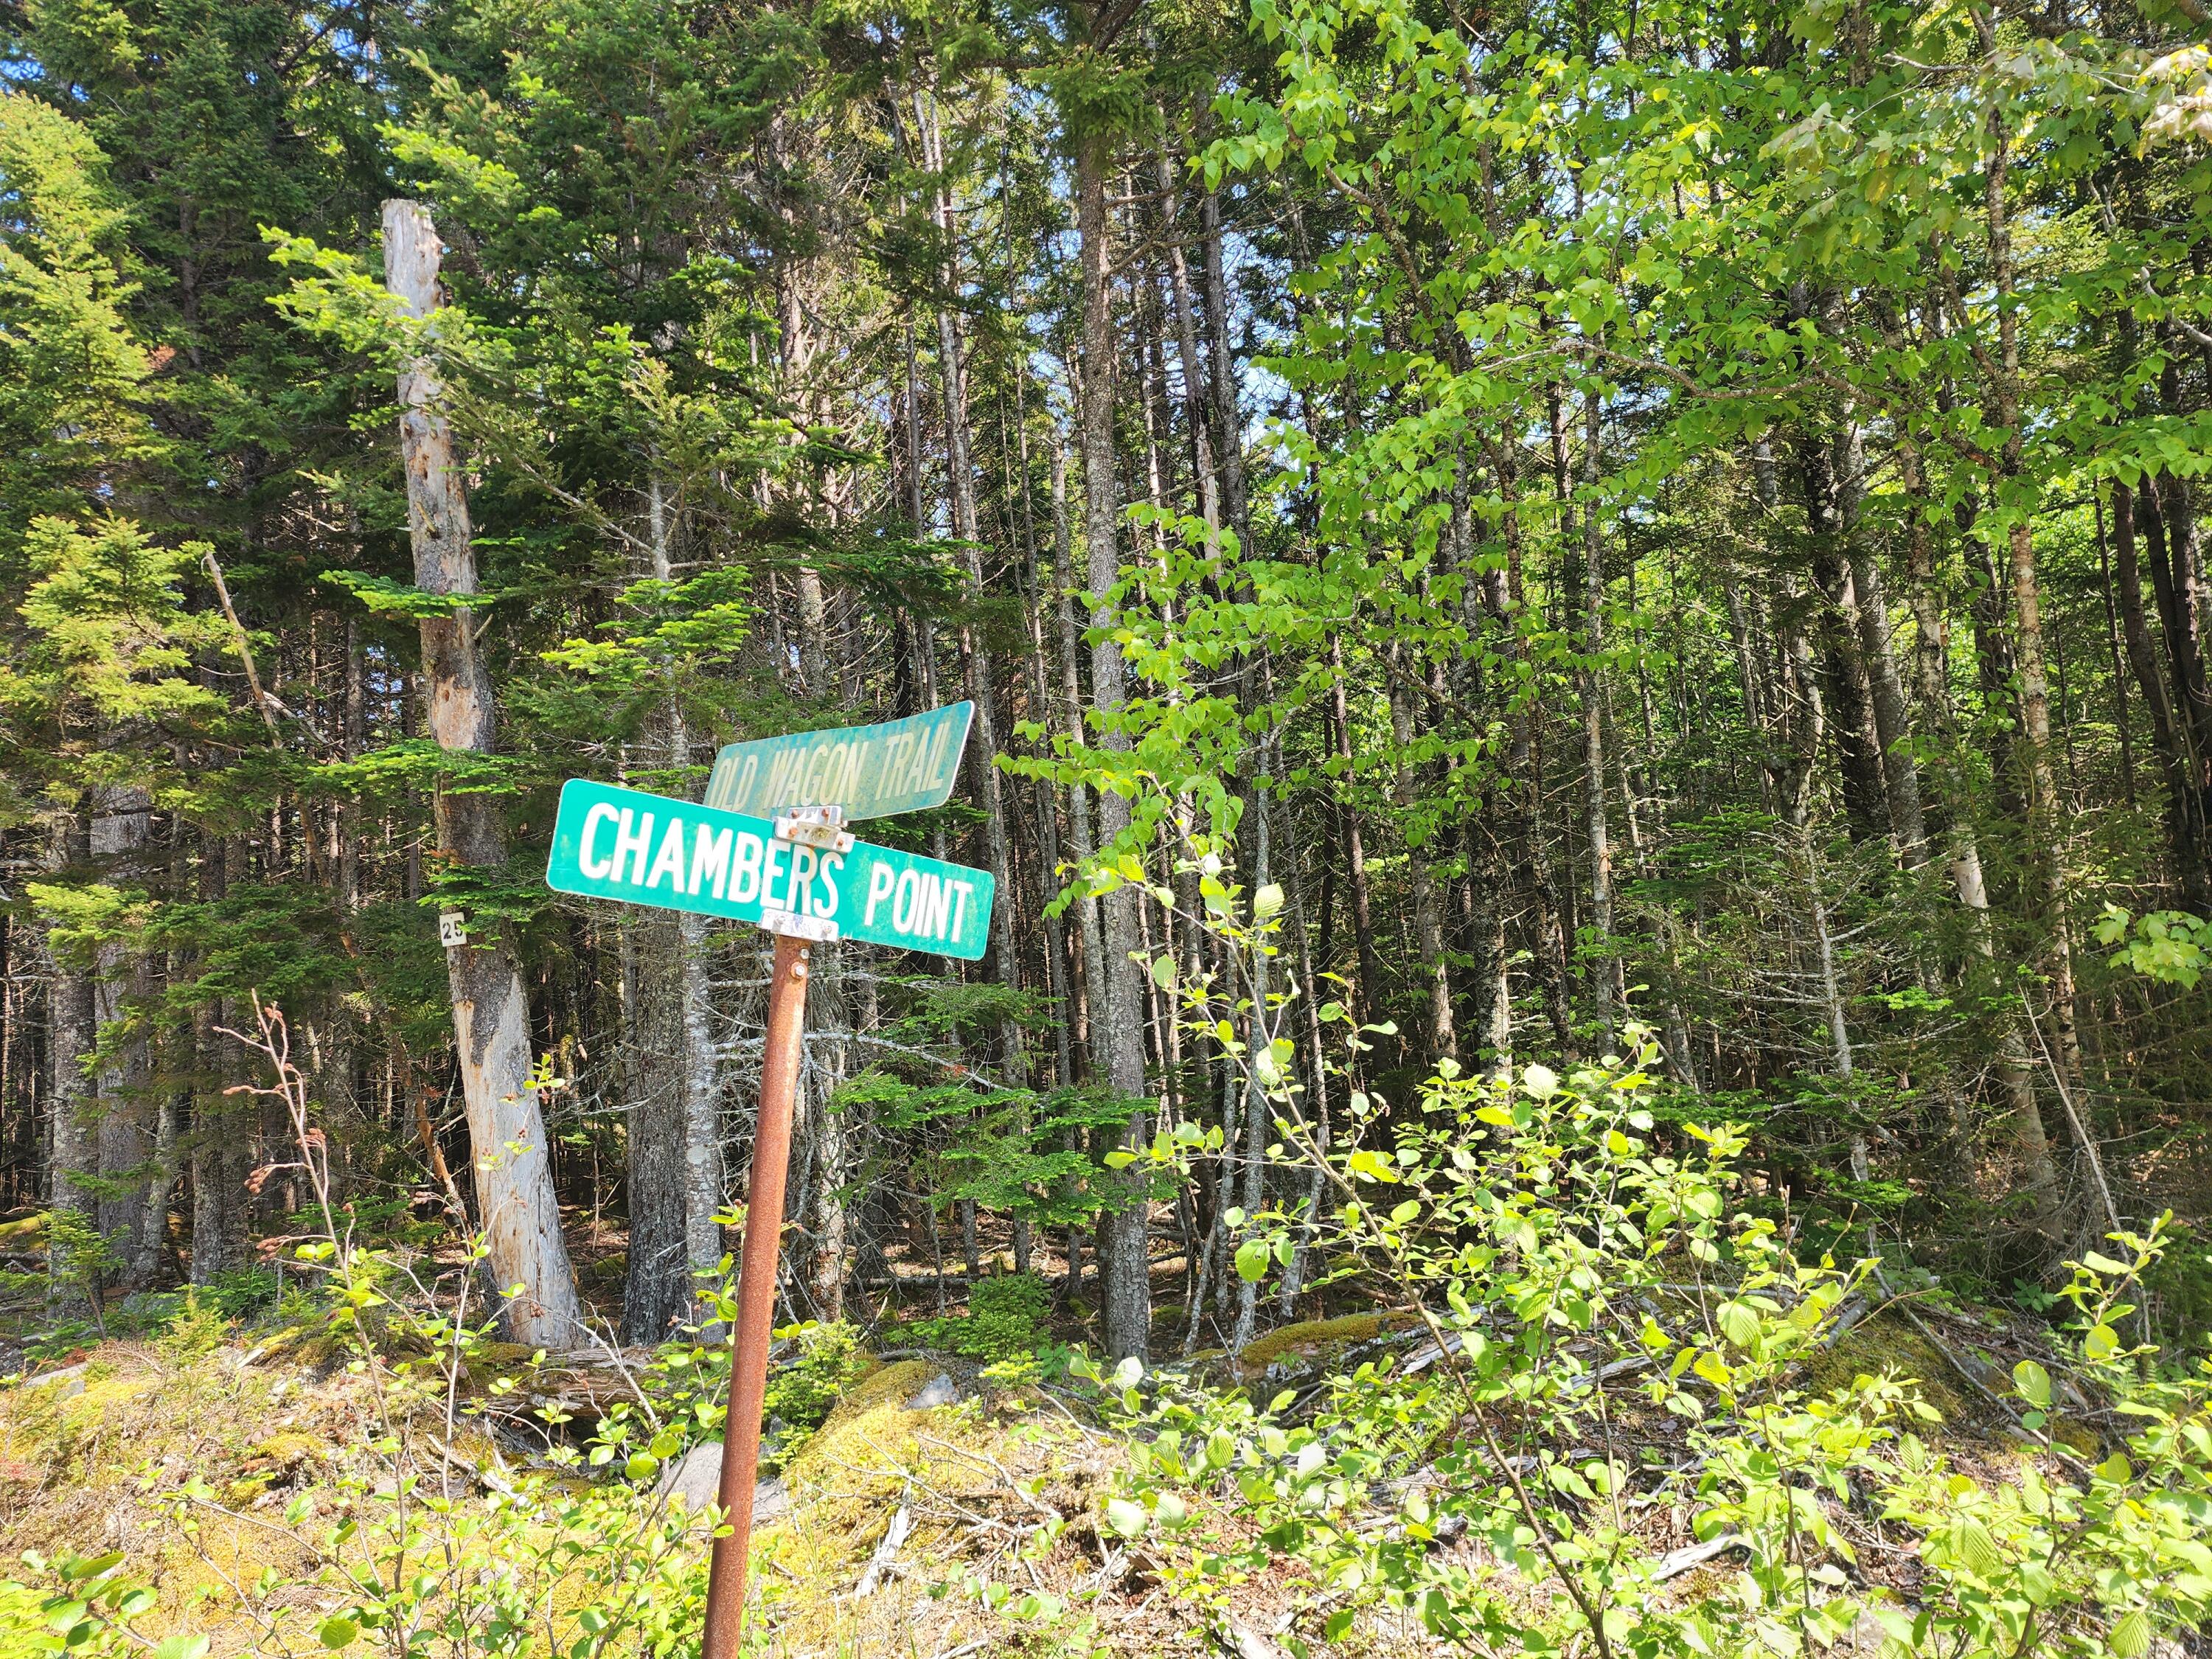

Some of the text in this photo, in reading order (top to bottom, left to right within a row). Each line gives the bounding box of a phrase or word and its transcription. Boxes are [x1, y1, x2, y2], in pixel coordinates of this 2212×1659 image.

[709, 721, 950, 812] OLD WAGON TRAIL
[578, 801, 973, 943] CHAMBERS POINT
[442, 920, 464, 939] 25
